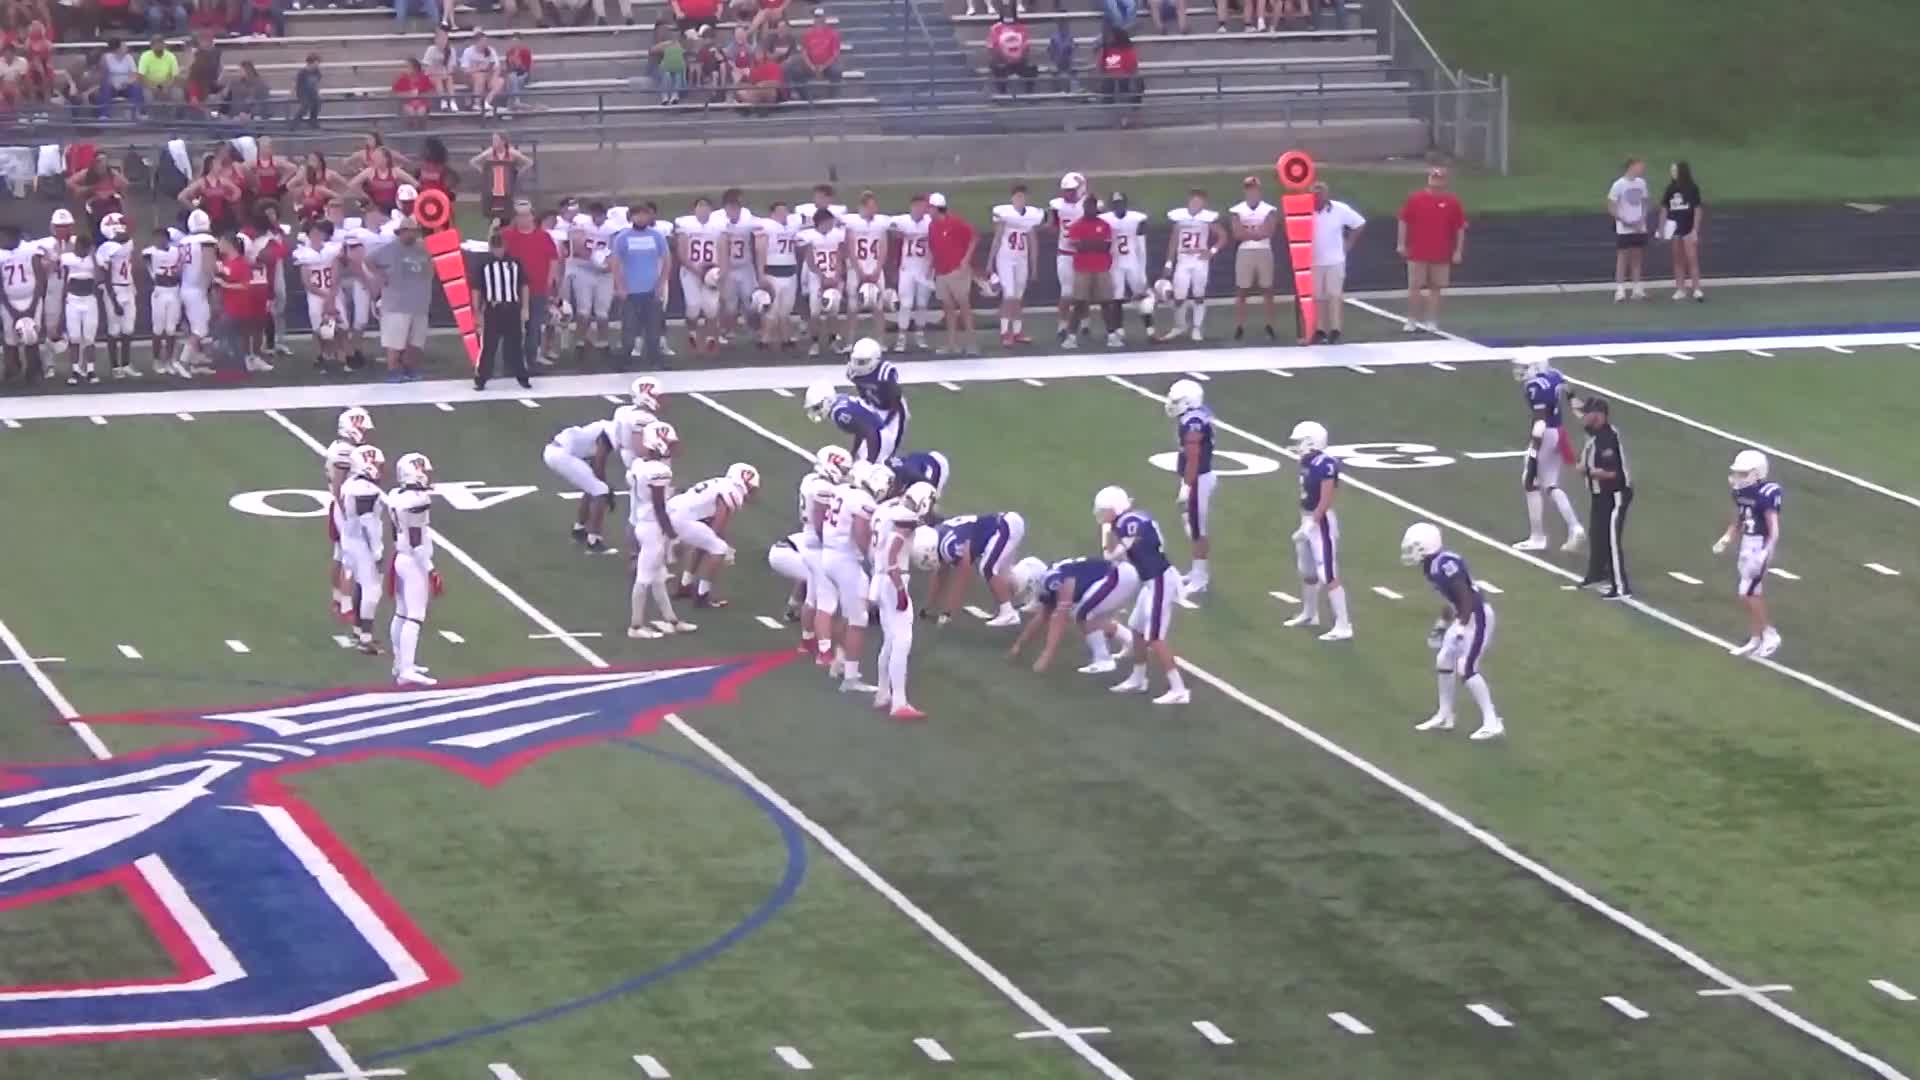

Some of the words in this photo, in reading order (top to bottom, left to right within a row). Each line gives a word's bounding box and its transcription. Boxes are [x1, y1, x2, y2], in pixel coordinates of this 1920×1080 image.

[689, 239, 715, 263] 66
[856, 238, 879, 260] 64
[1181, 231, 1201, 249] 21
[3, 263, 28, 286] 71
[311, 267, 333, 289] 38
